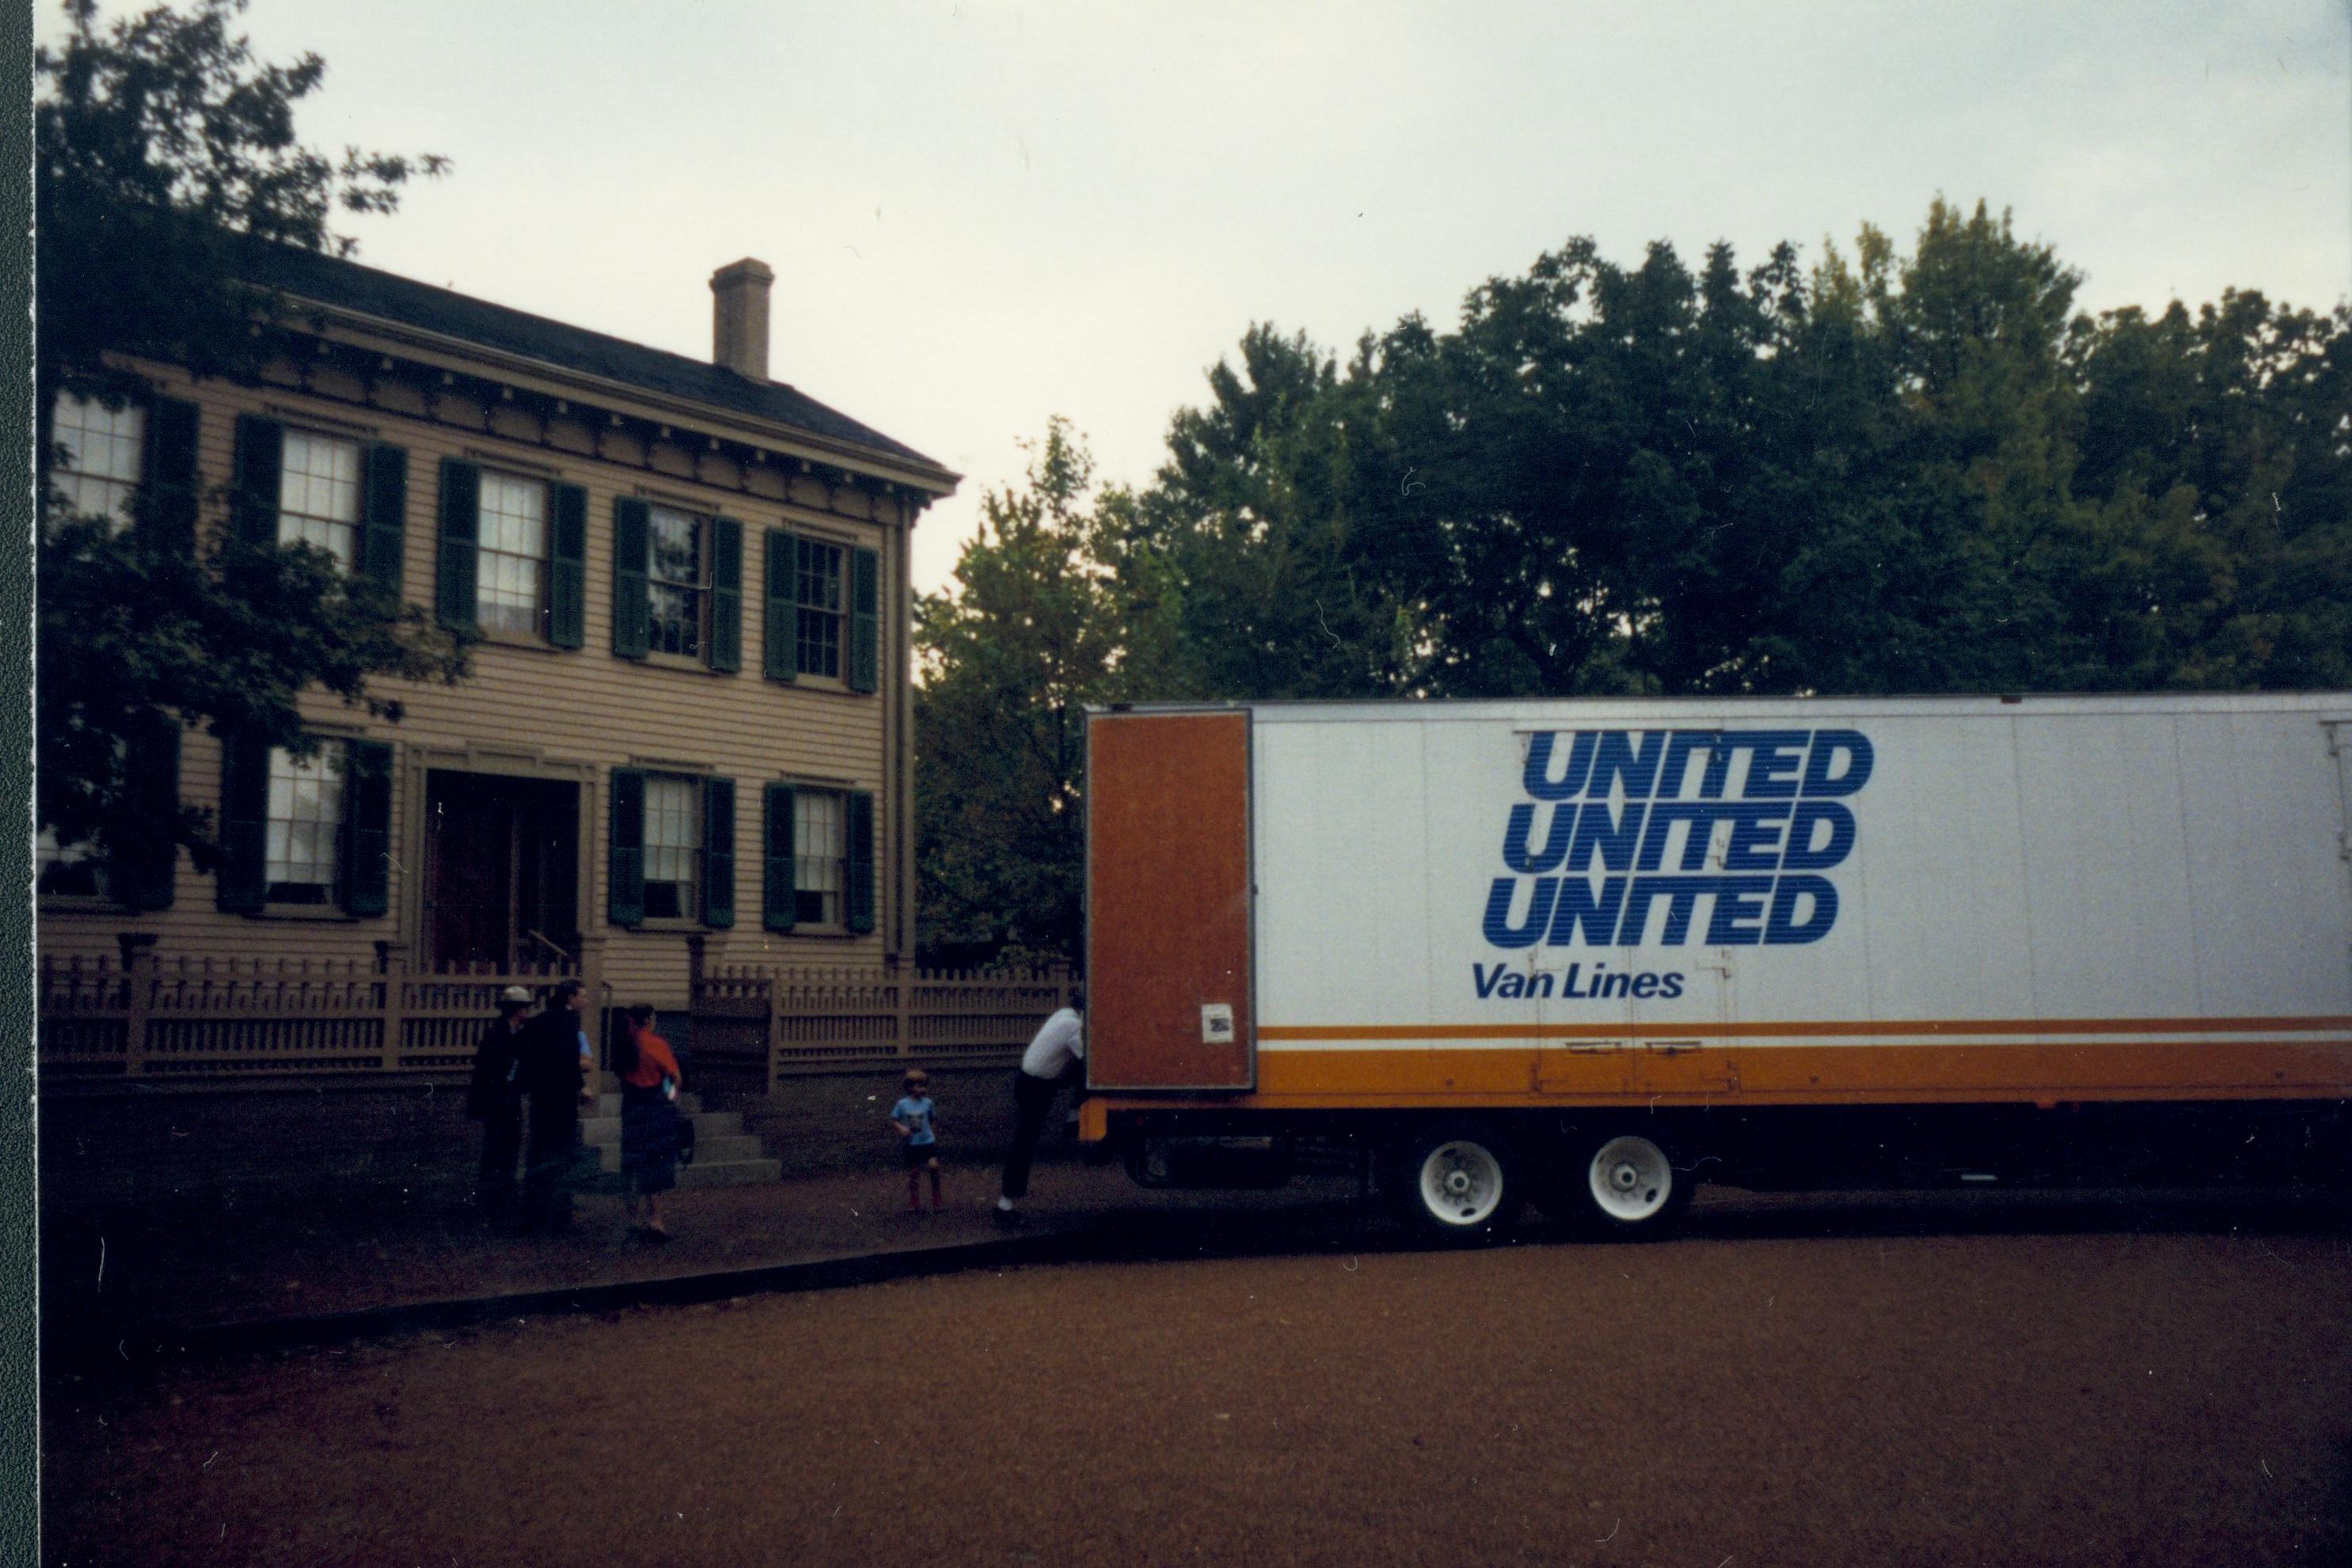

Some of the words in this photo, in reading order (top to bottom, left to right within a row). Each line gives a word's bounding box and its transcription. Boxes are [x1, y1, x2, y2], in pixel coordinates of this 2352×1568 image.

[1522, 729, 1875, 801] UNITED
[1503, 800, 1856, 874] UNITED
[1482, 875, 1839, 949] UNITED
[1472, 962, 1554, 999] Van
[1562, 962, 1685, 999] Lines
